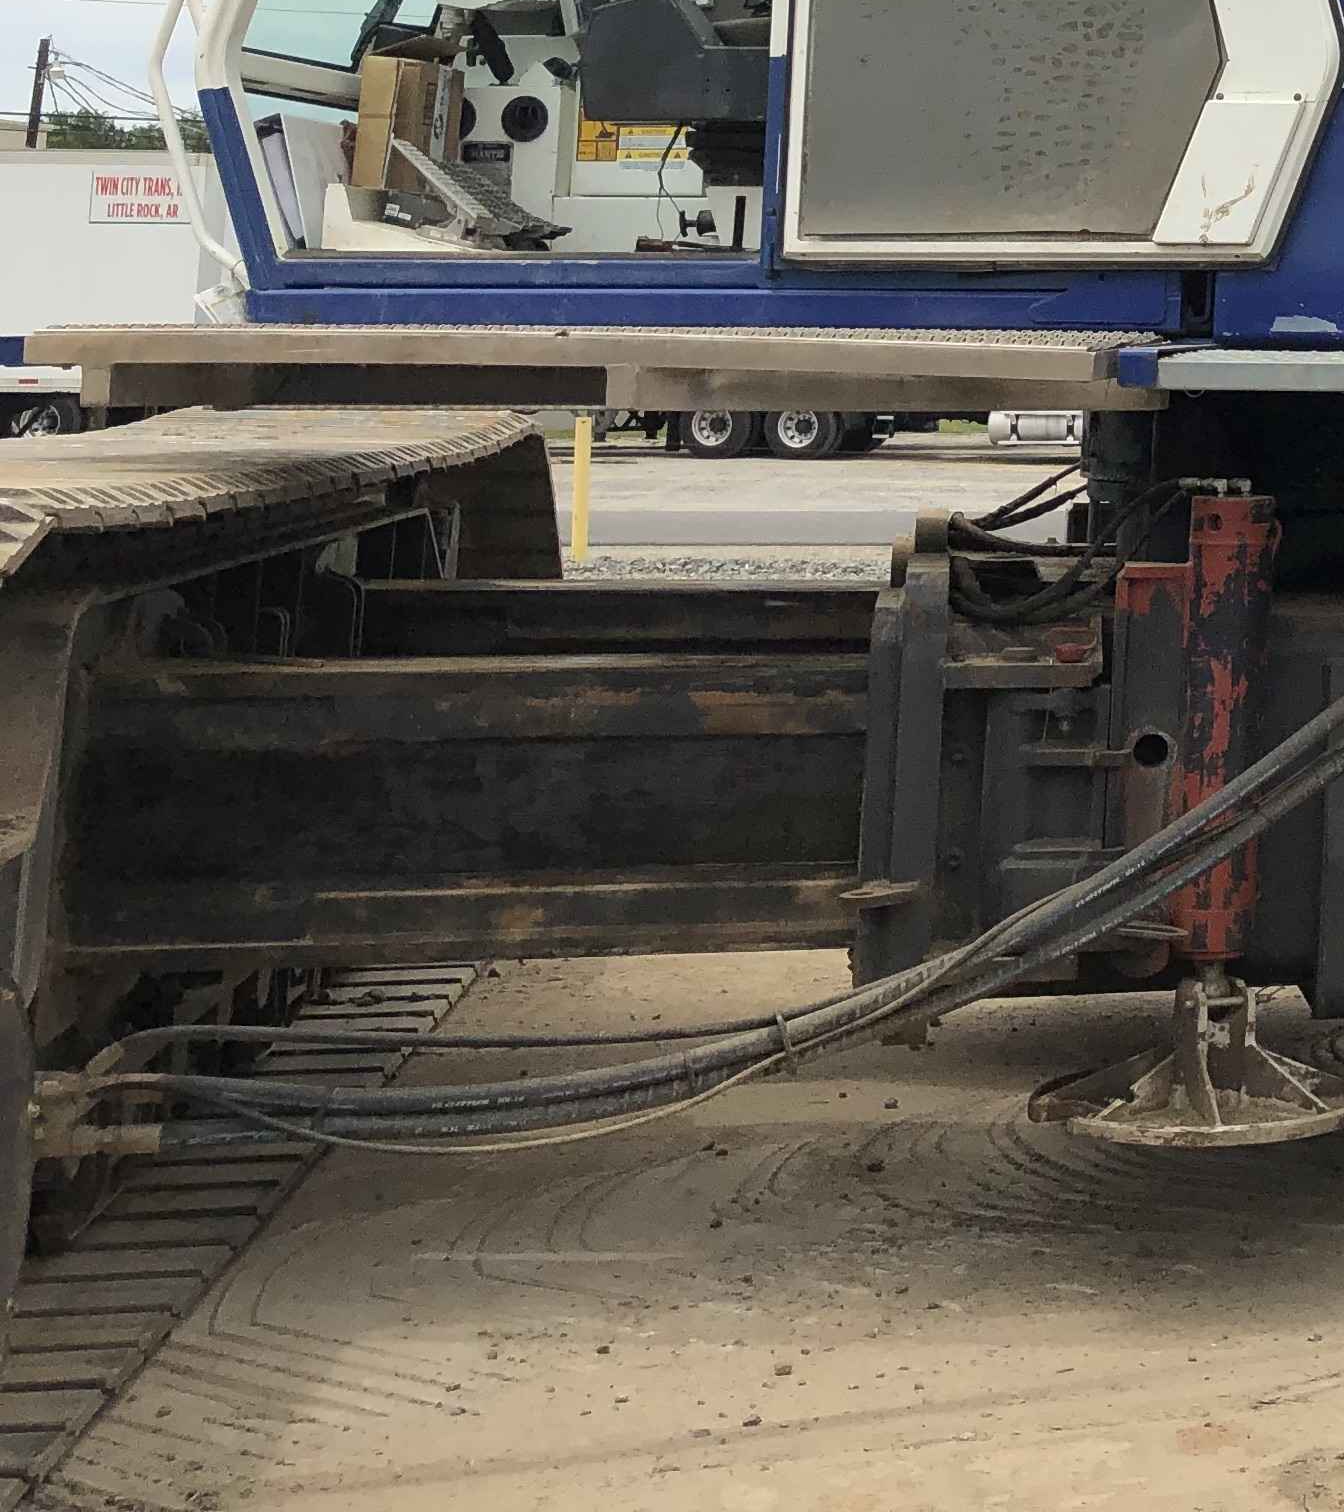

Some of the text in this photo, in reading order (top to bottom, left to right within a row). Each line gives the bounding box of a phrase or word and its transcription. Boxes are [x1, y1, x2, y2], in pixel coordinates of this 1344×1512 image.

[95, 176, 119, 196] TWIN
[120, 176, 140, 196] CITY
[143, 177, 175, 199] TRANS,
[107, 202, 179, 219] LITTLE ROCK, AR
